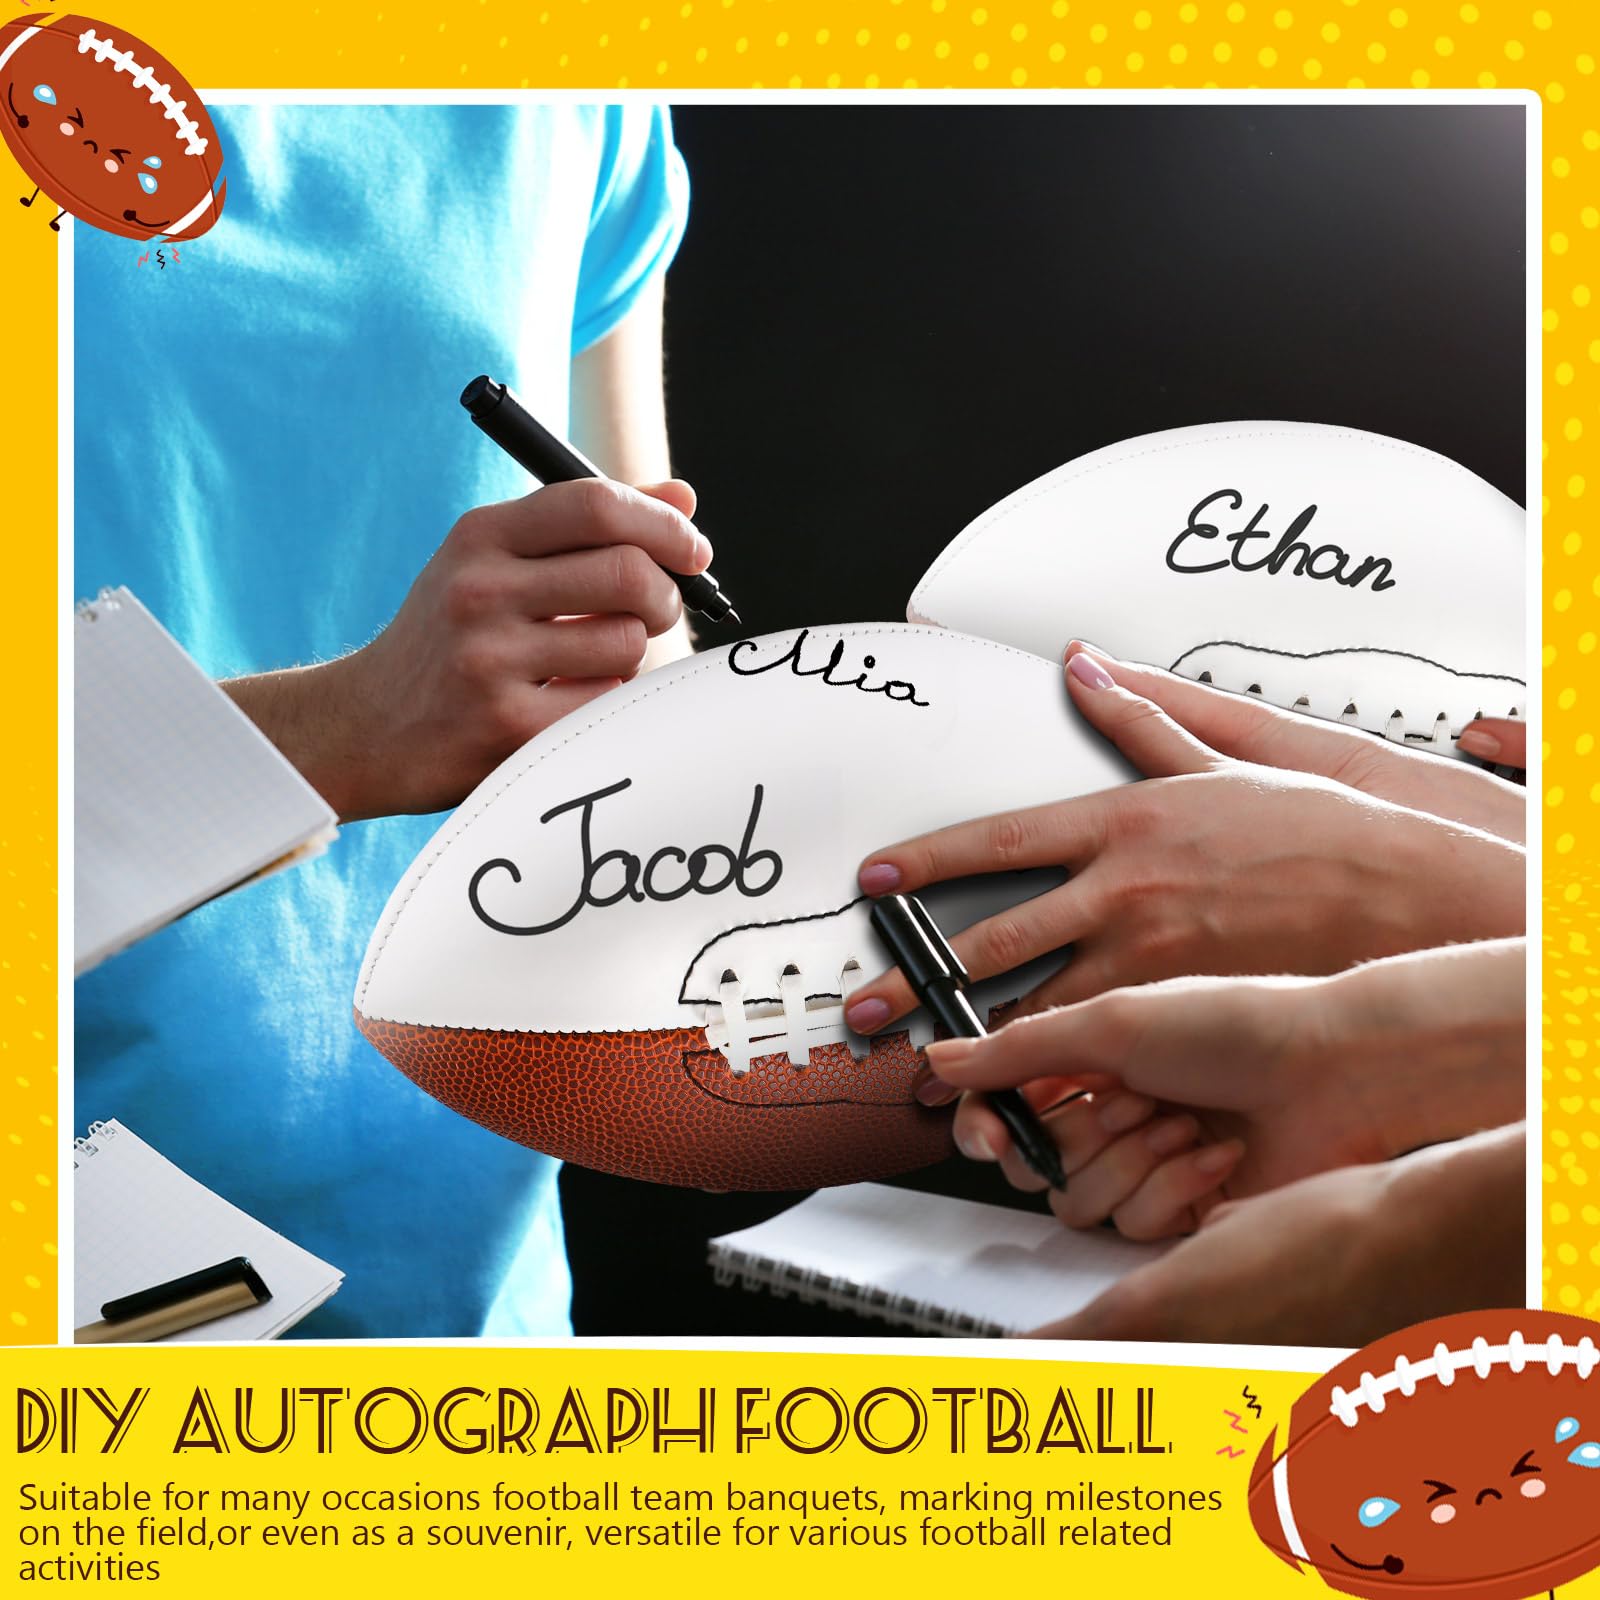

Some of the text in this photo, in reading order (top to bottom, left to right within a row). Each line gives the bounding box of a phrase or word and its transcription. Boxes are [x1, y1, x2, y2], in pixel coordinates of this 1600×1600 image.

[1166, 488, 1396, 592] Ethan
[728, 629, 930, 707] Mia
[468, 777, 783, 936] Jacob
